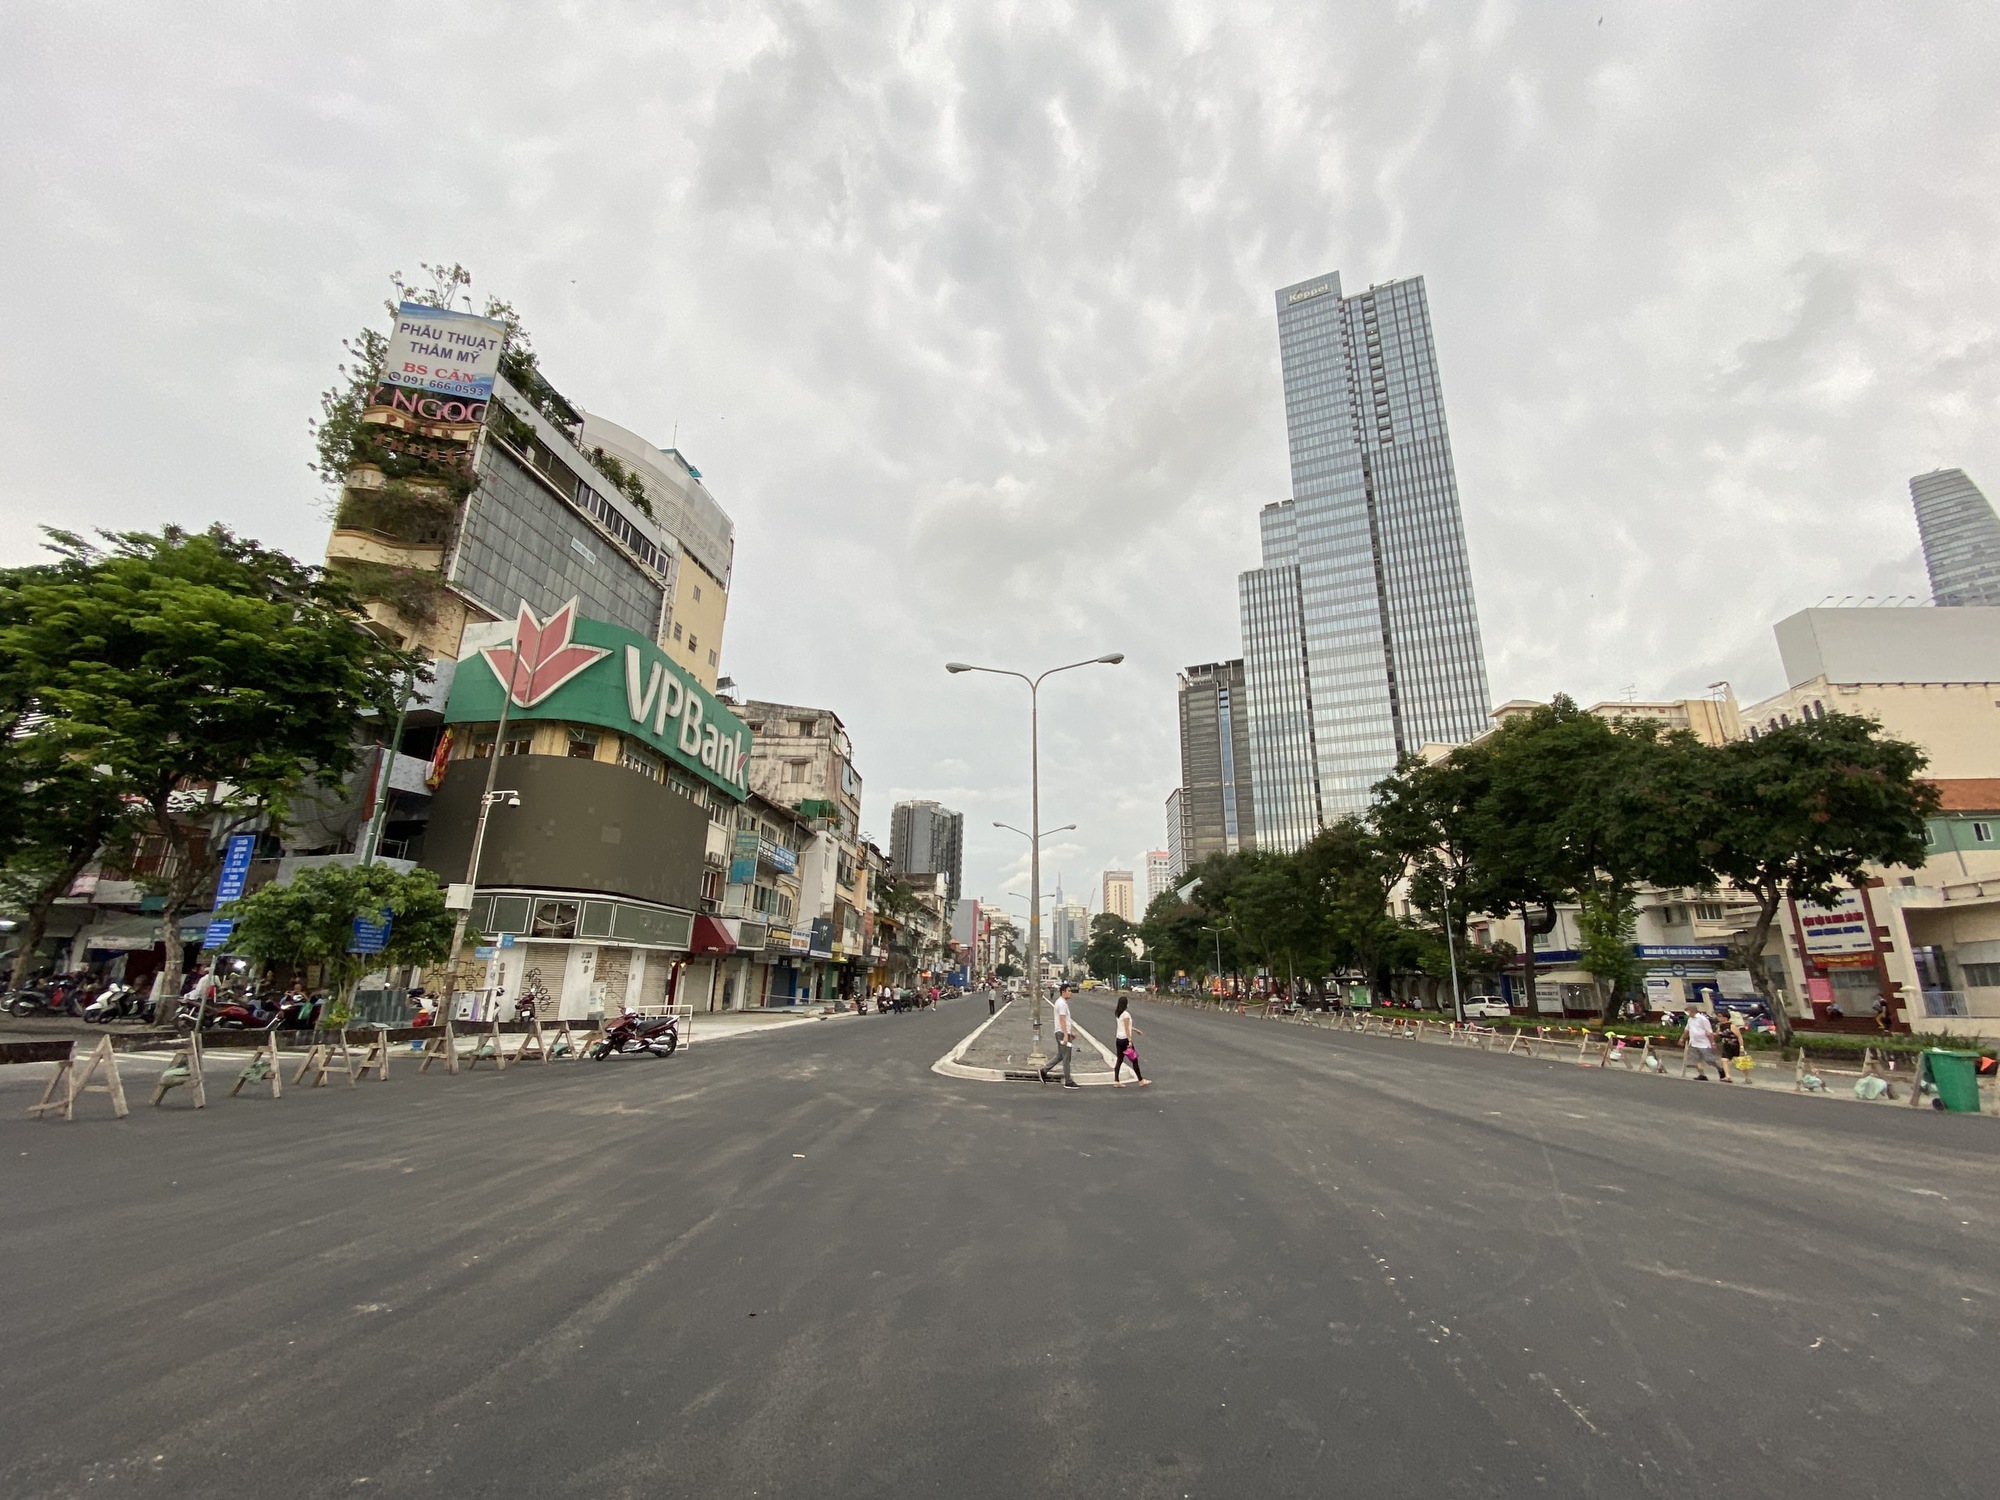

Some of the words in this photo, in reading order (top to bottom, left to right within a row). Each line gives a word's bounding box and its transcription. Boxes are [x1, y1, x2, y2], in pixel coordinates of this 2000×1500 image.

[1289, 284, 1328, 301] Keppel
[456, 350, 480, 364] MỸ
[402, 362, 428, 375] BS
[403, 375, 424, 386] 091
[429, 379, 451, 391] 666
[455, 384, 484, 396] 0593
[624, 644, 748, 790] VPBank
